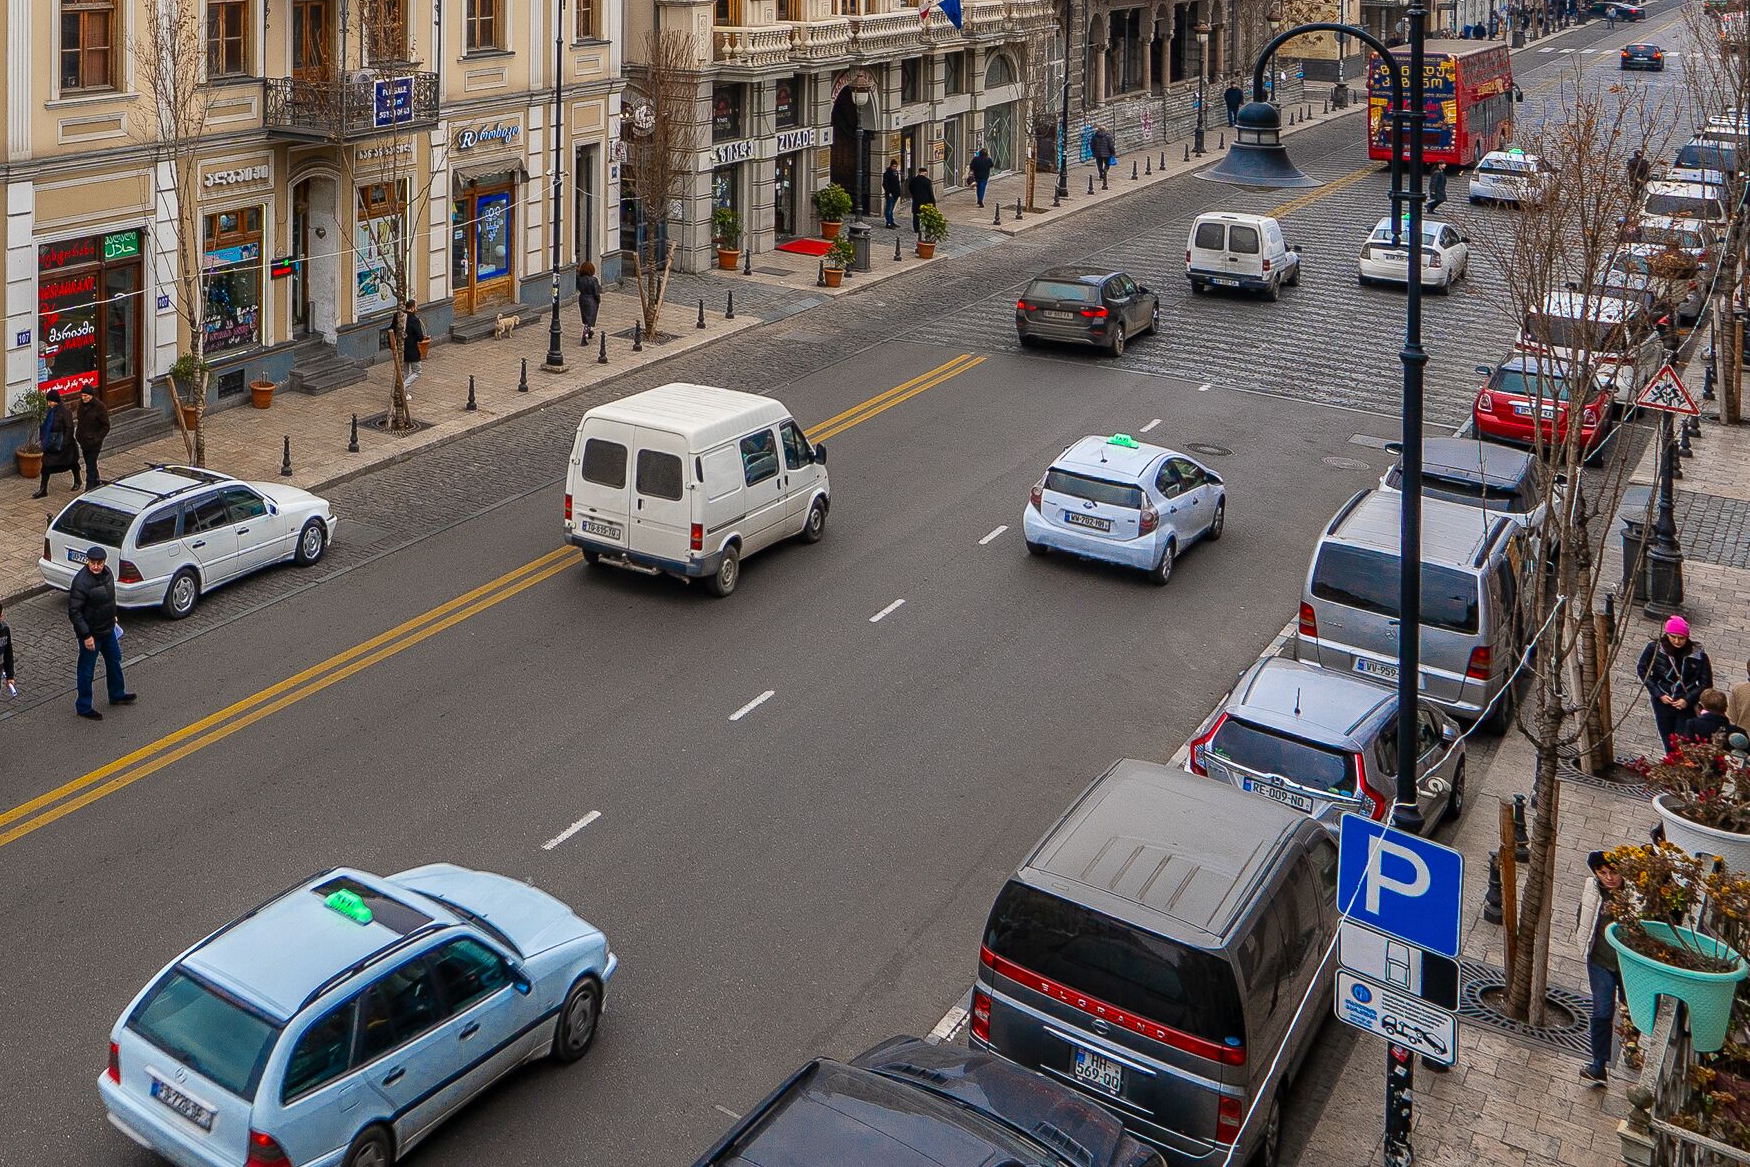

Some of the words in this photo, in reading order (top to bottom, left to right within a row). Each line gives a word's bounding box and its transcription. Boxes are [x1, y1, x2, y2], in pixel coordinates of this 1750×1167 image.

[779, 129, 816, 151] ZIYADE
[18, 333, 30, 344] 107
[49, 320, 95, 343] მარიამი
[1365, 834, 1431, 916] P
[1041, 981, 1166, 1039] ELGRAND
